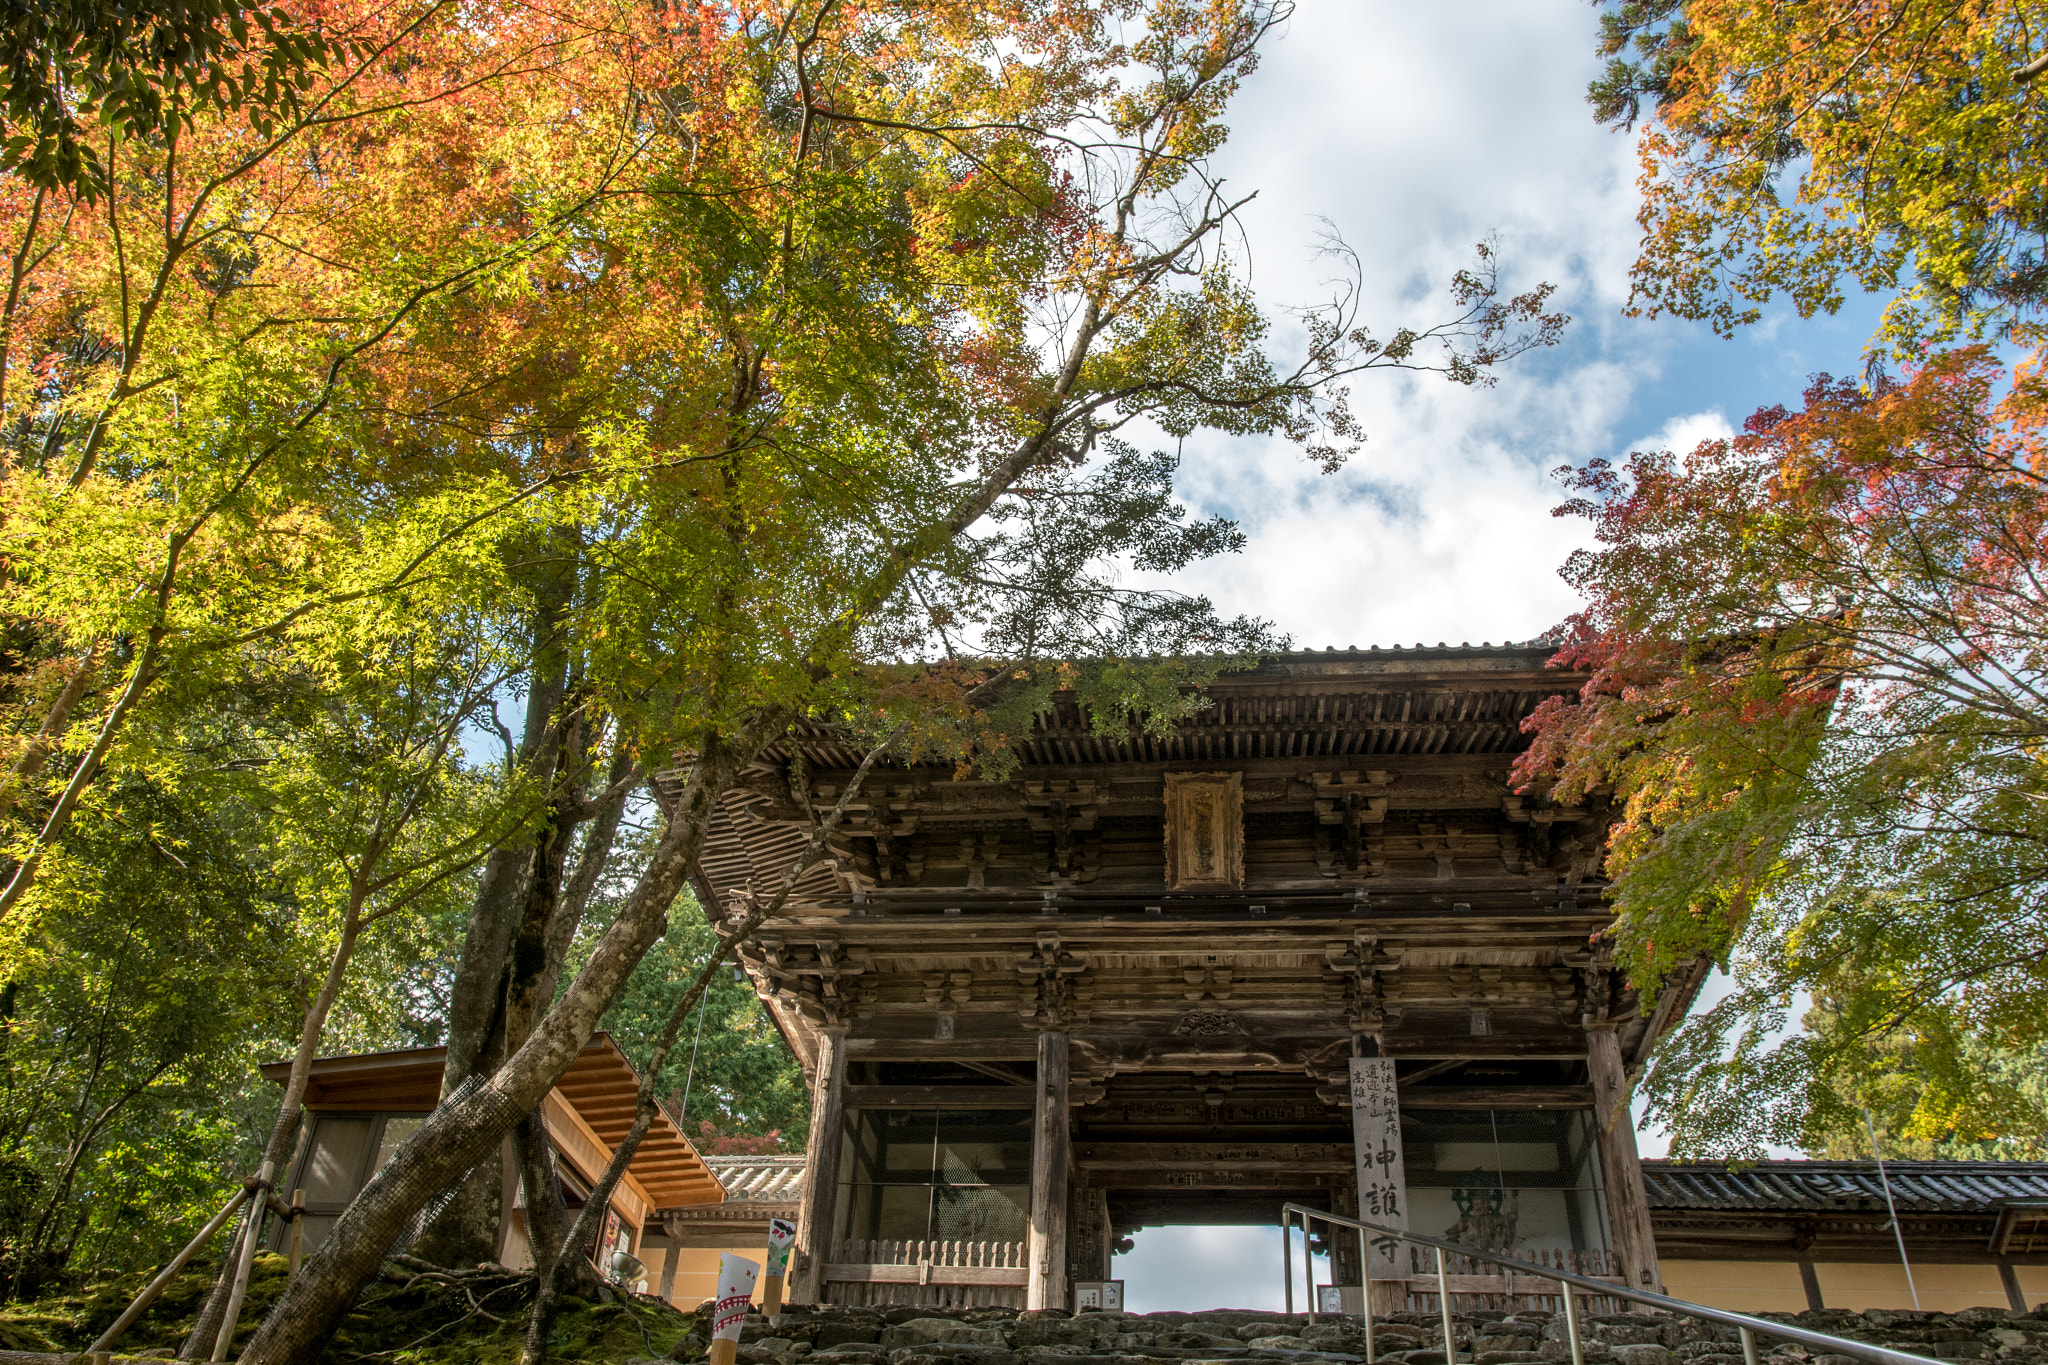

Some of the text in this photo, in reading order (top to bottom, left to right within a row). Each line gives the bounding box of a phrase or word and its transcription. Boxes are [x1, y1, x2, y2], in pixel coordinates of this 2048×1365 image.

[1352, 1070, 1367, 1110] 高雄山
[1362, 1138, 1402, 1265] 神護寺
[1107, 1285, 1117, 1305] 入口
